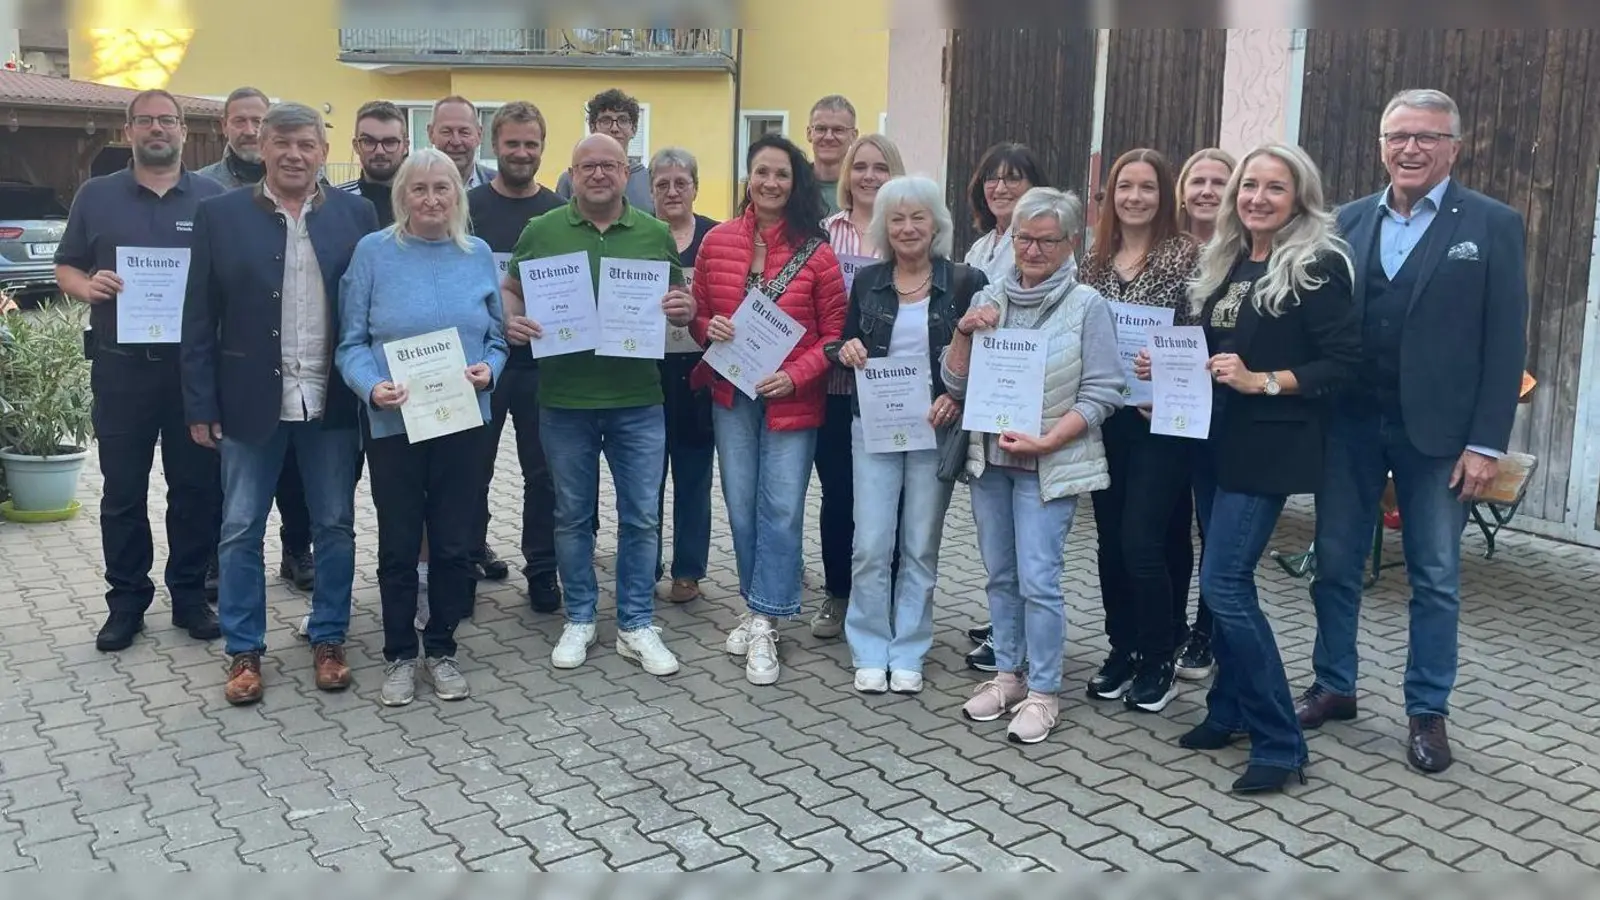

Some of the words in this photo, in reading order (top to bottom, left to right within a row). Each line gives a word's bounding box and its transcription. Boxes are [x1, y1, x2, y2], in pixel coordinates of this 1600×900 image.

[127, 256, 180, 268] Urkunde
[528, 264, 580, 280] Urkunde
[609, 267, 660, 281] Urkunde
[752, 300, 793, 337] Urkunde
[983, 336, 1038, 351] Urkunde
[1153, 336, 1198, 349] Urkunde
[396, 341, 451, 361] Urkunde
[864, 366, 918, 380] Urkunde
